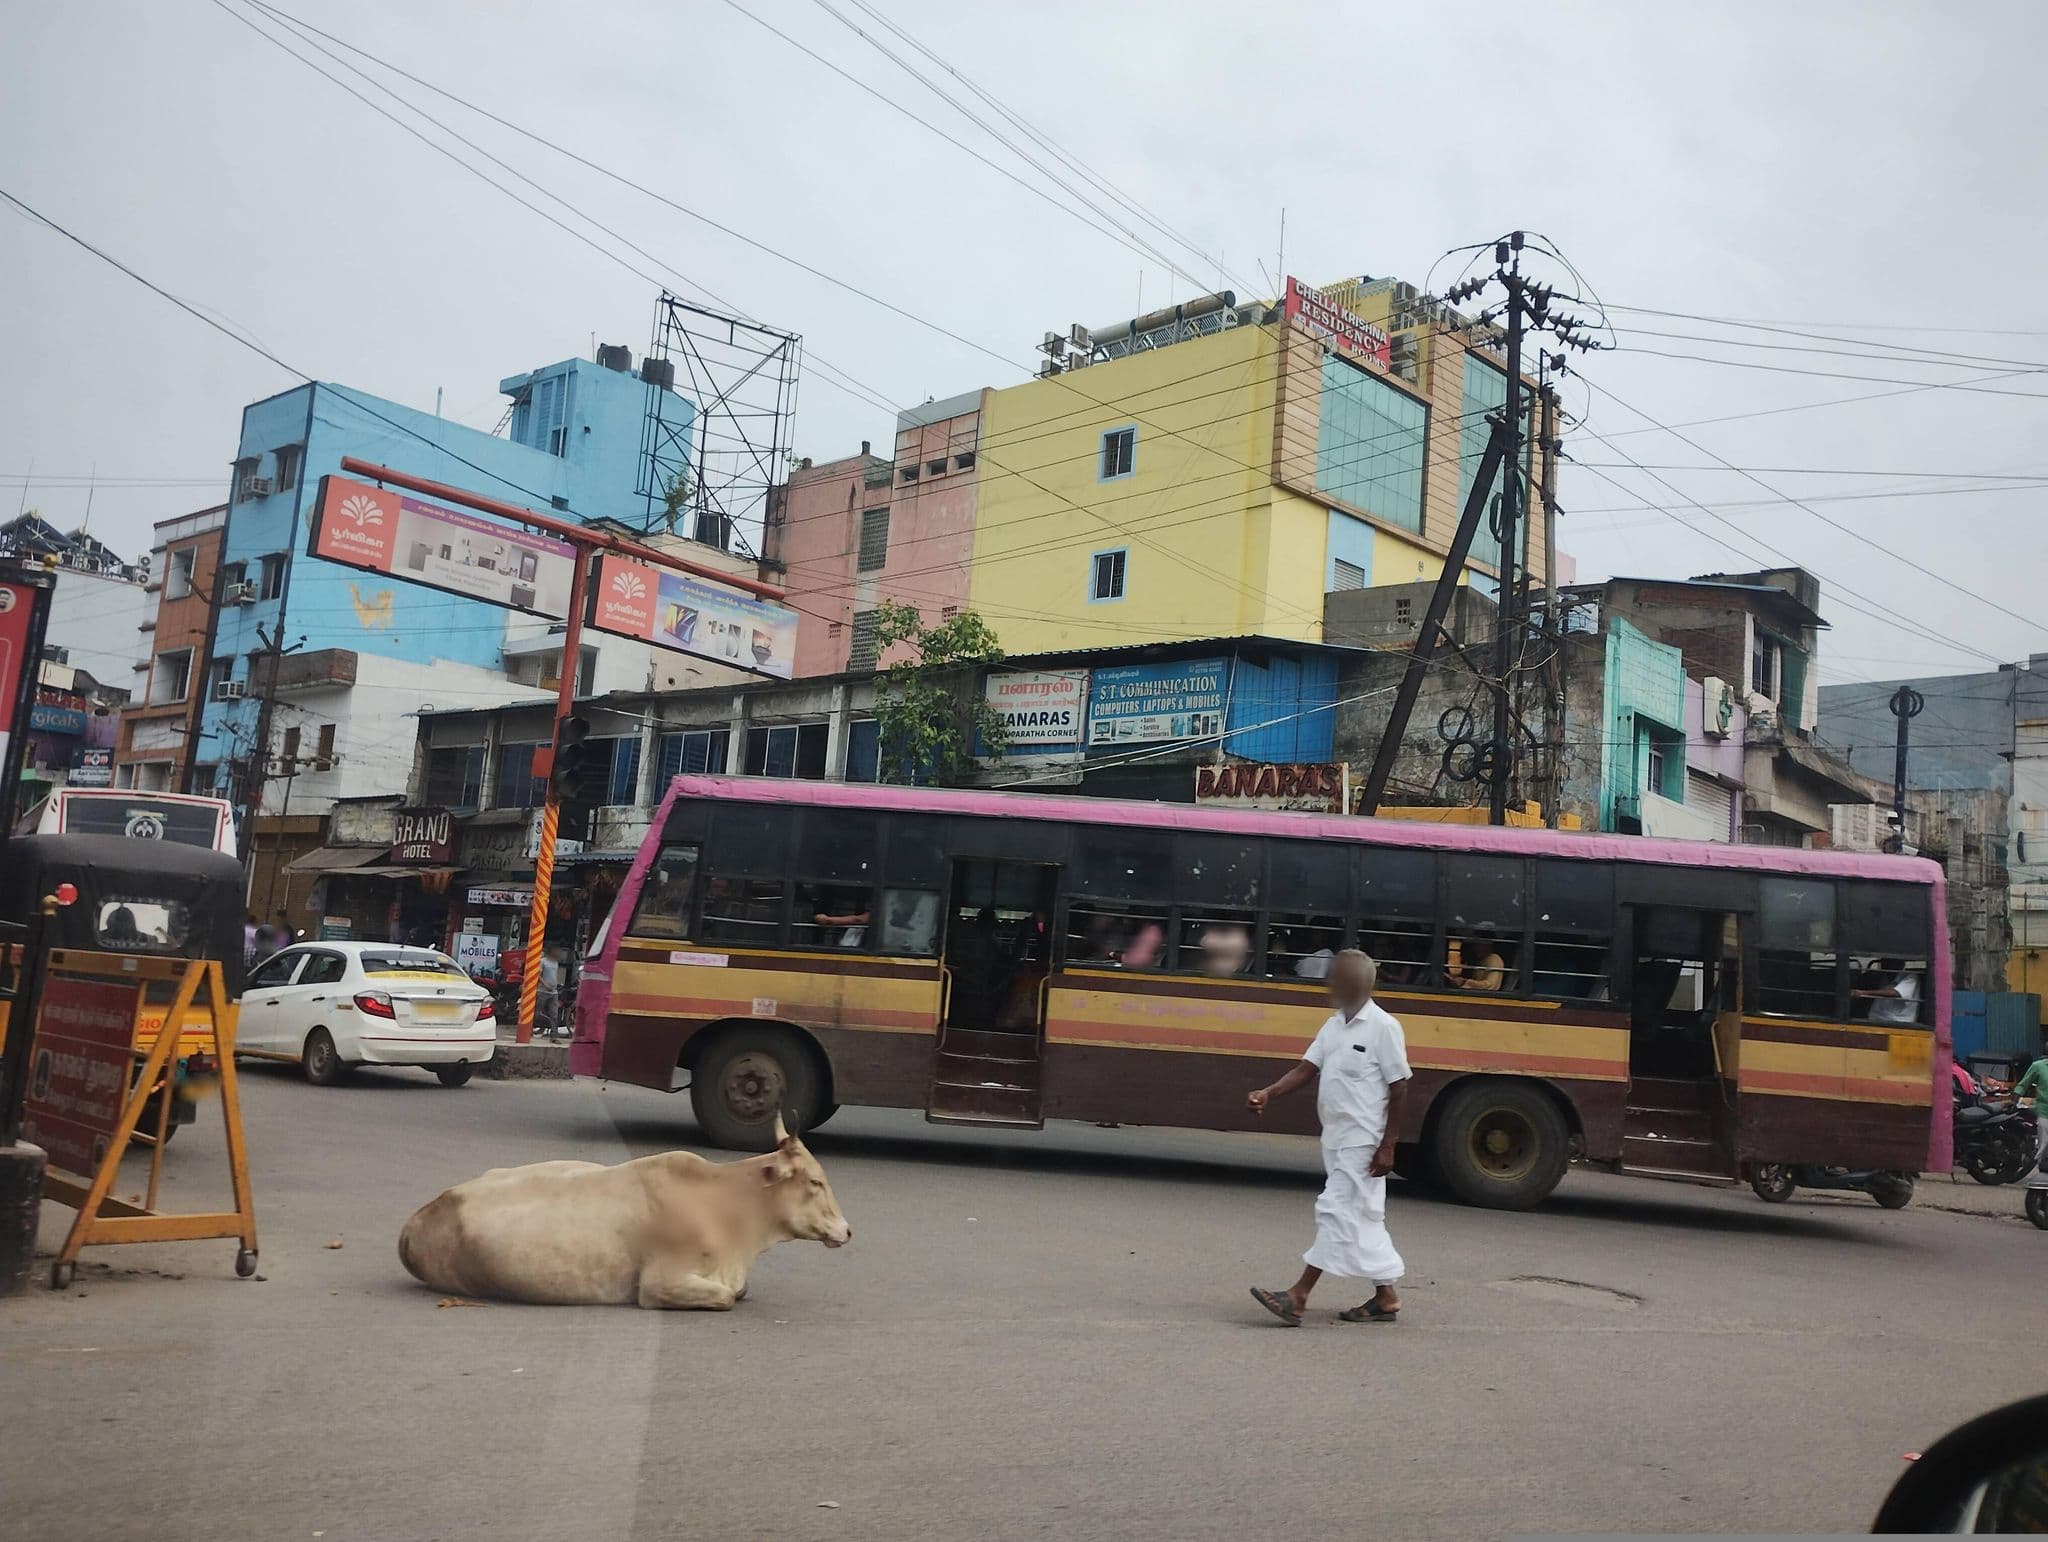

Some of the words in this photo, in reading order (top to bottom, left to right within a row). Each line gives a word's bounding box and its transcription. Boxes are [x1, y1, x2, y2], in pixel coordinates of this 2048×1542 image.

[1295, 281, 1338, 315] CHELLA
[1341, 307, 1387, 345] KRISHNA
[1302, 300, 1380, 352] RESIDENCY
[1352, 344, 1386, 370] ROOMS
[1120, 675, 1218, 698] COMMUNICATION
[1178, 699, 1184, 710] &
[1186, 694, 1220, 709] MOBILES
[996, 710, 1071, 727] ANARAS
[1197, 766, 1339, 798] BANARAS
[392, 812, 450, 846] GRAND
[402, 844, 432, 859] HOTEL
[460, 947, 496, 958] MOBILES
